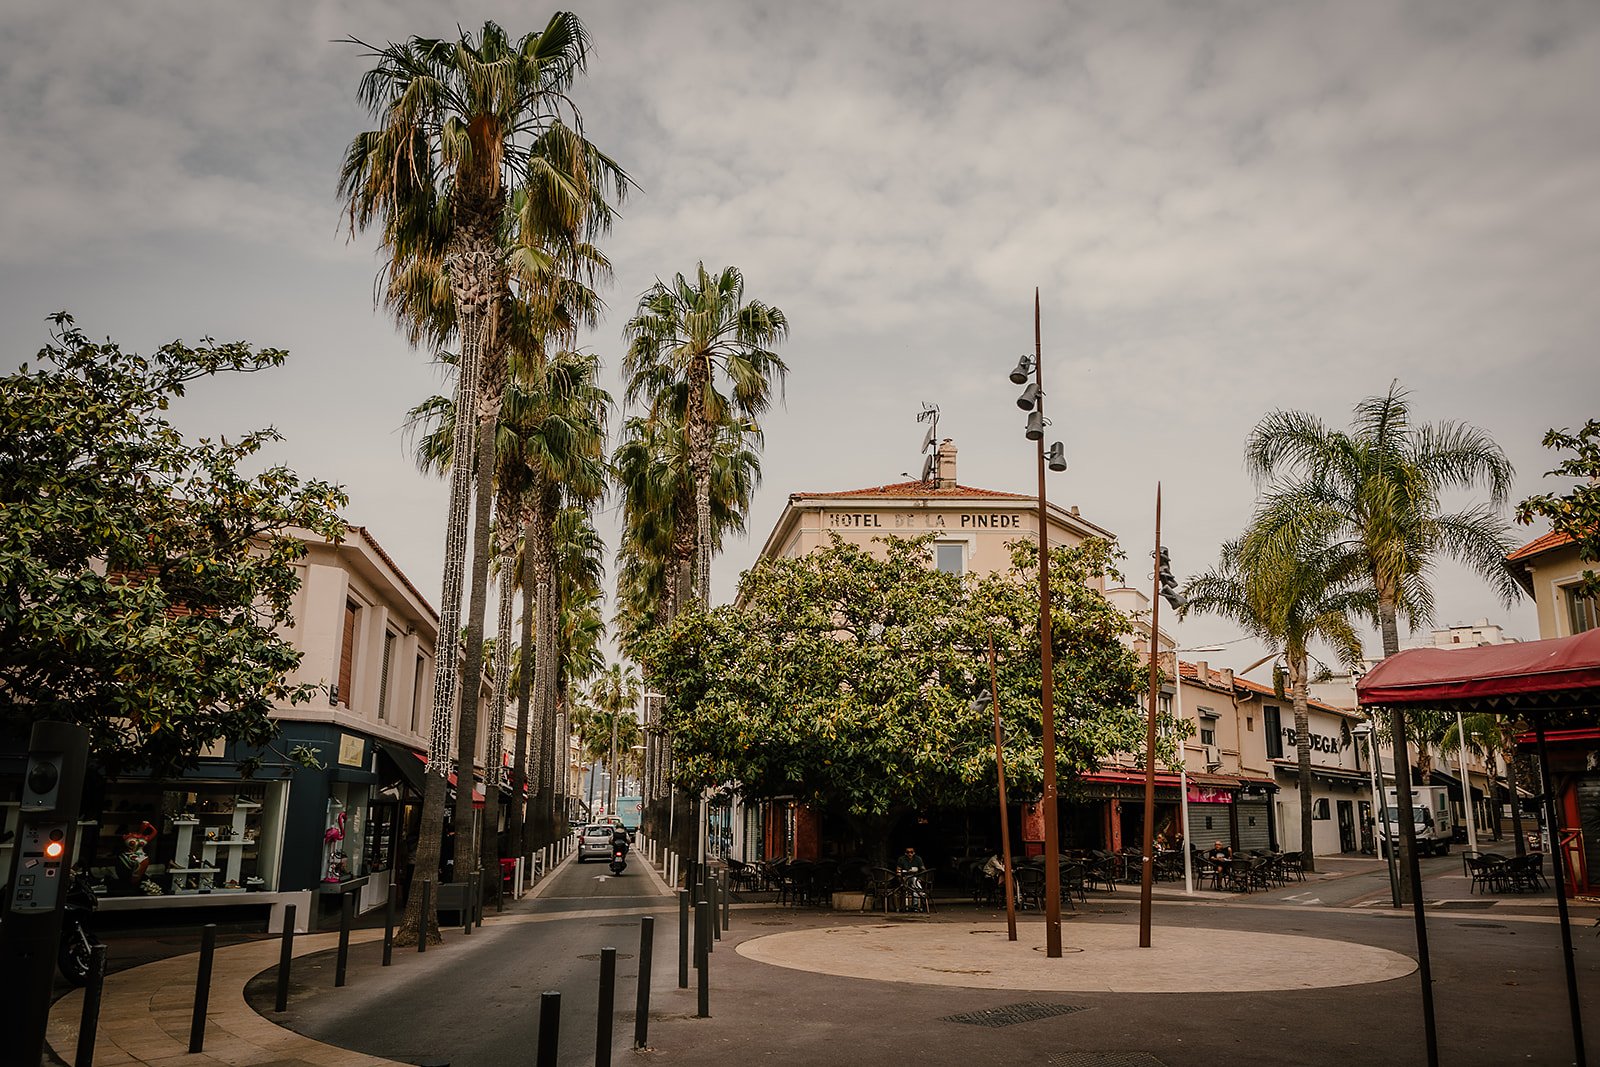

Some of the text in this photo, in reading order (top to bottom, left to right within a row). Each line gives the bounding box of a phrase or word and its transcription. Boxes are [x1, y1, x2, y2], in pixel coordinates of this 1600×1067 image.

[830, 513, 882, 527] HOTEL
[895, 513, 914, 528] DE
[925, 513, 946, 528] LA
[1287, 727, 1340, 754] BDEGA
